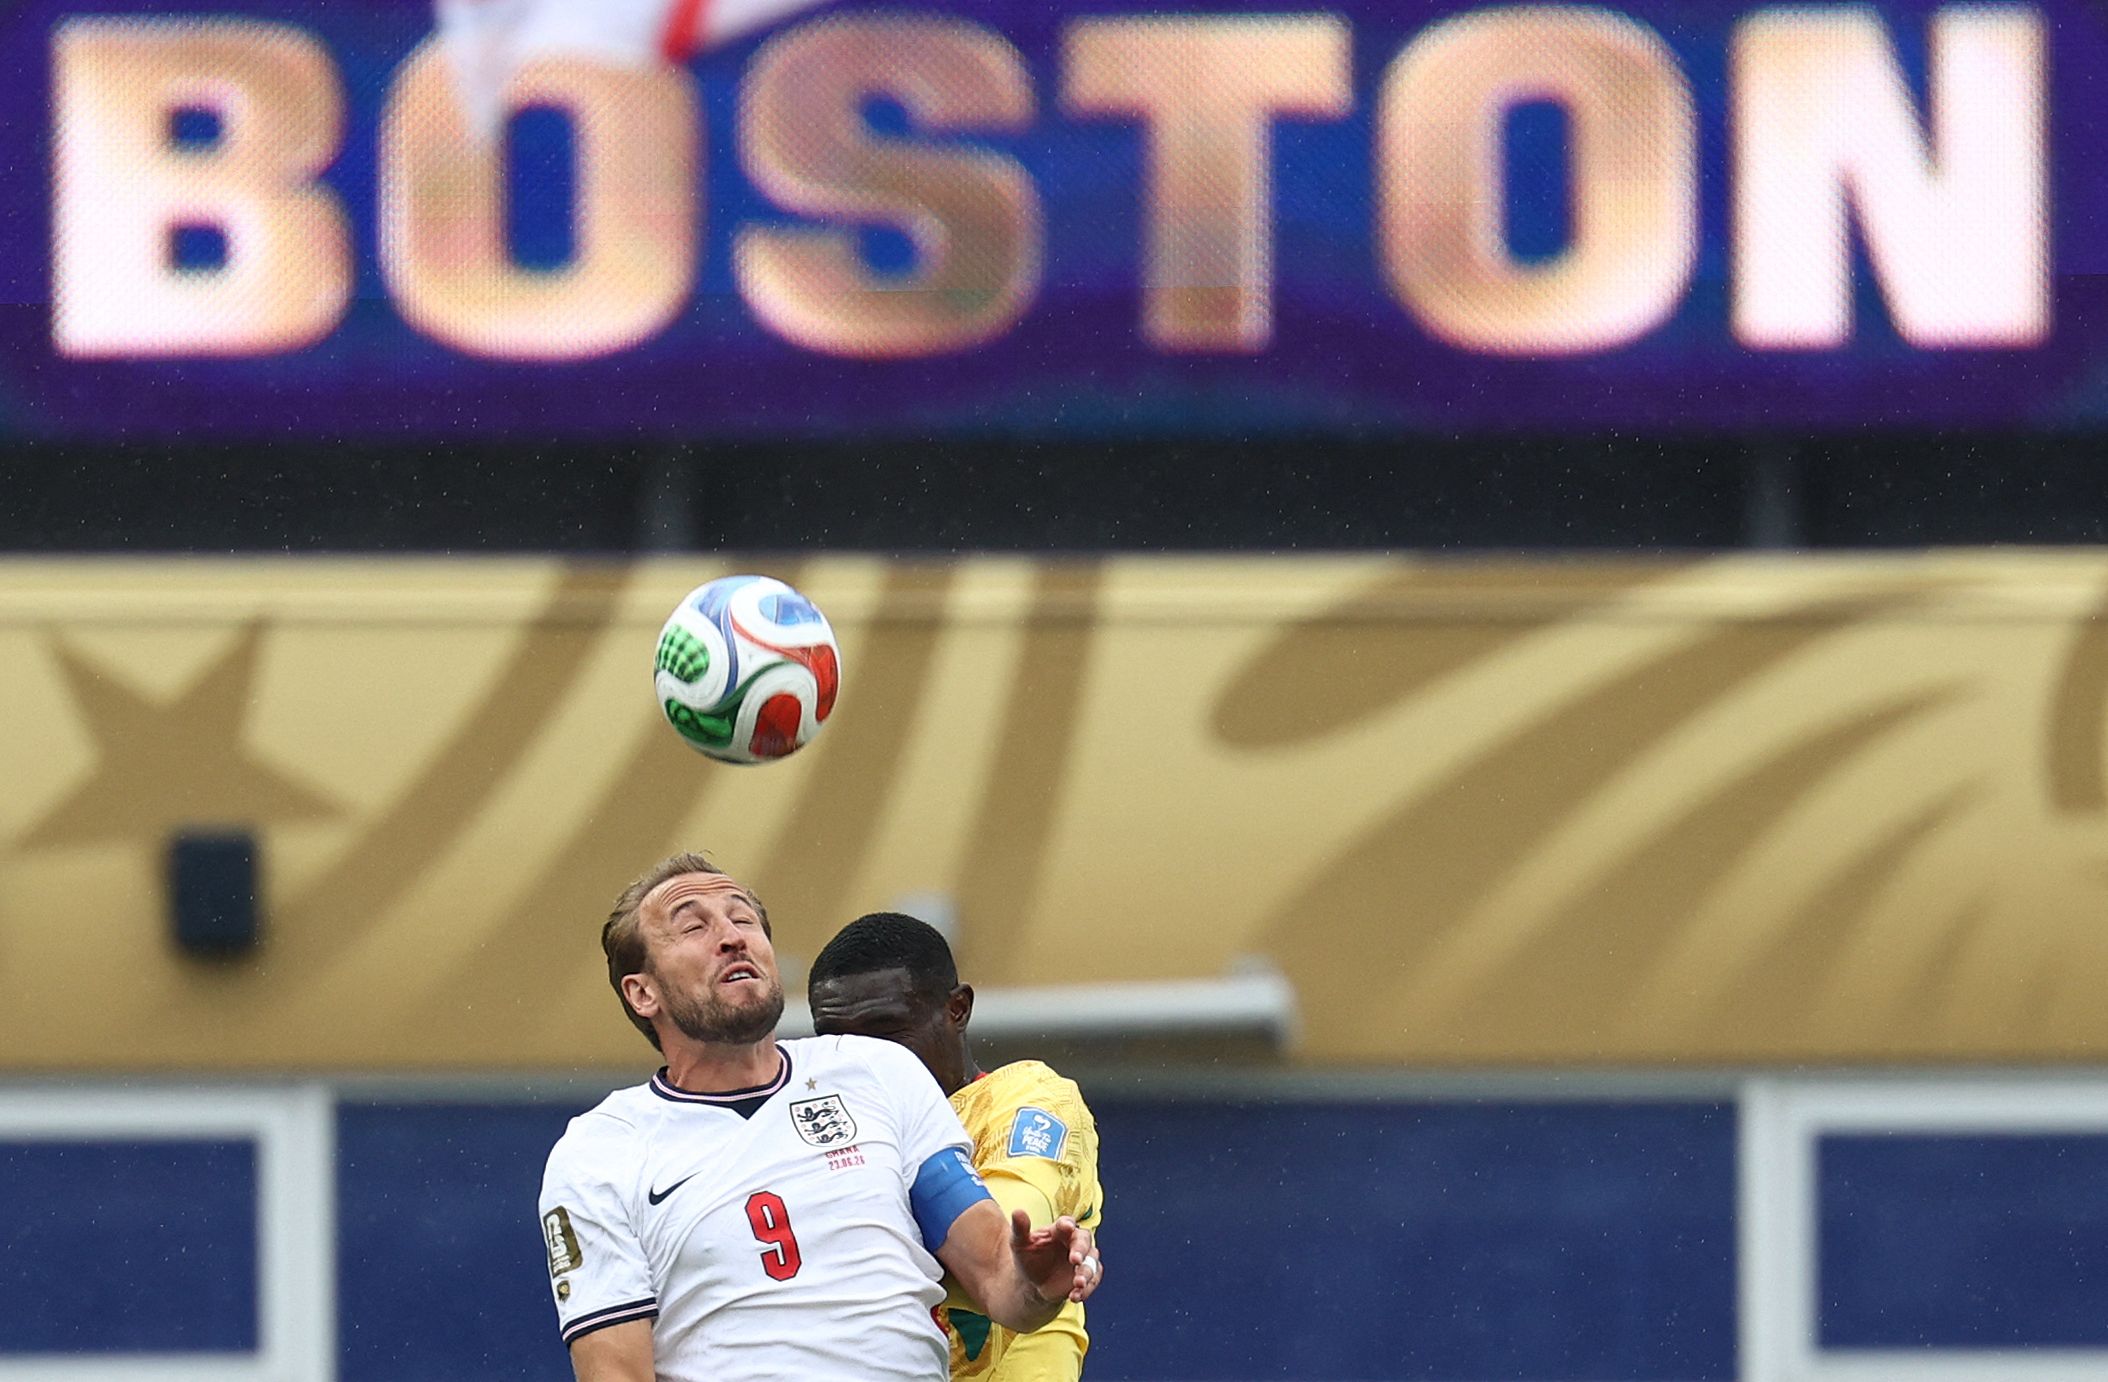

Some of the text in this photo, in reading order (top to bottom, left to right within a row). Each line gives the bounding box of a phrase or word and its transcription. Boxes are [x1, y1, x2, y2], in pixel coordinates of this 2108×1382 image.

[50, 6, 2050, 358] BOSTON
[825, 1145, 859, 1158] GHANA
[828, 1155, 865, 1171] 23.06.26
[744, 1190, 802, 1282] 9
